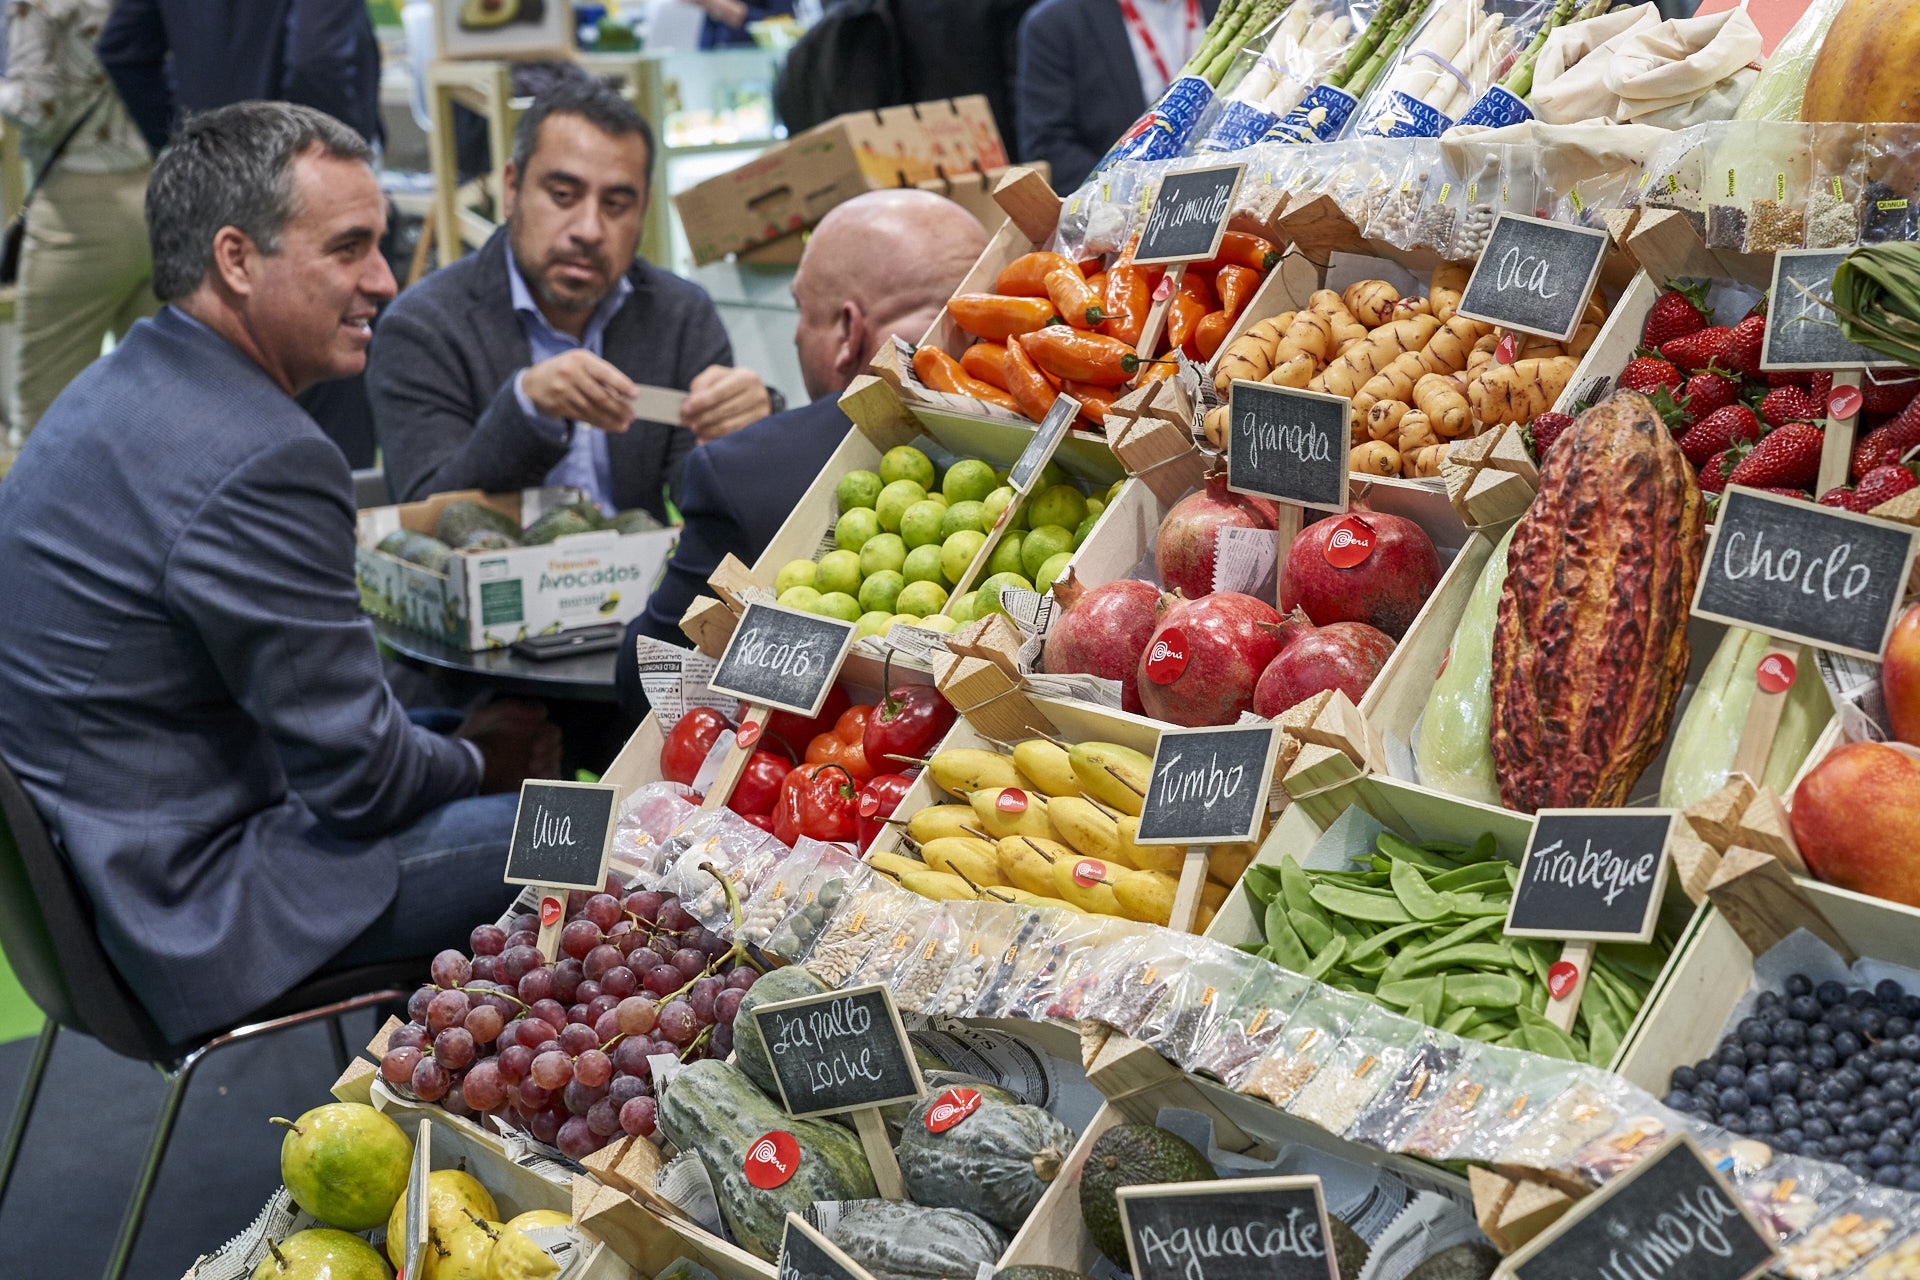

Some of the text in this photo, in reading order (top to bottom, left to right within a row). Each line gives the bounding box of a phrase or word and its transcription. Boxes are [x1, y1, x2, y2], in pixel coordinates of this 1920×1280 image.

[1777, 173, 1786, 202] QUINUA
[1496, 246, 1559, 299] Oca
[1243, 411, 1333, 470] granada
[538, 562, 640, 593] Avocados
[1723, 530, 1871, 603] Choclo
[663, 663, 681, 671] FIELD
[734, 627, 814, 677] Rocoto
[1157, 751, 1244, 810] Tumbo
[532, 804, 577, 849] Uva
[1533, 838, 1655, 907] Tirabeque
[1138, 1207, 1327, 1280] Aguacate
